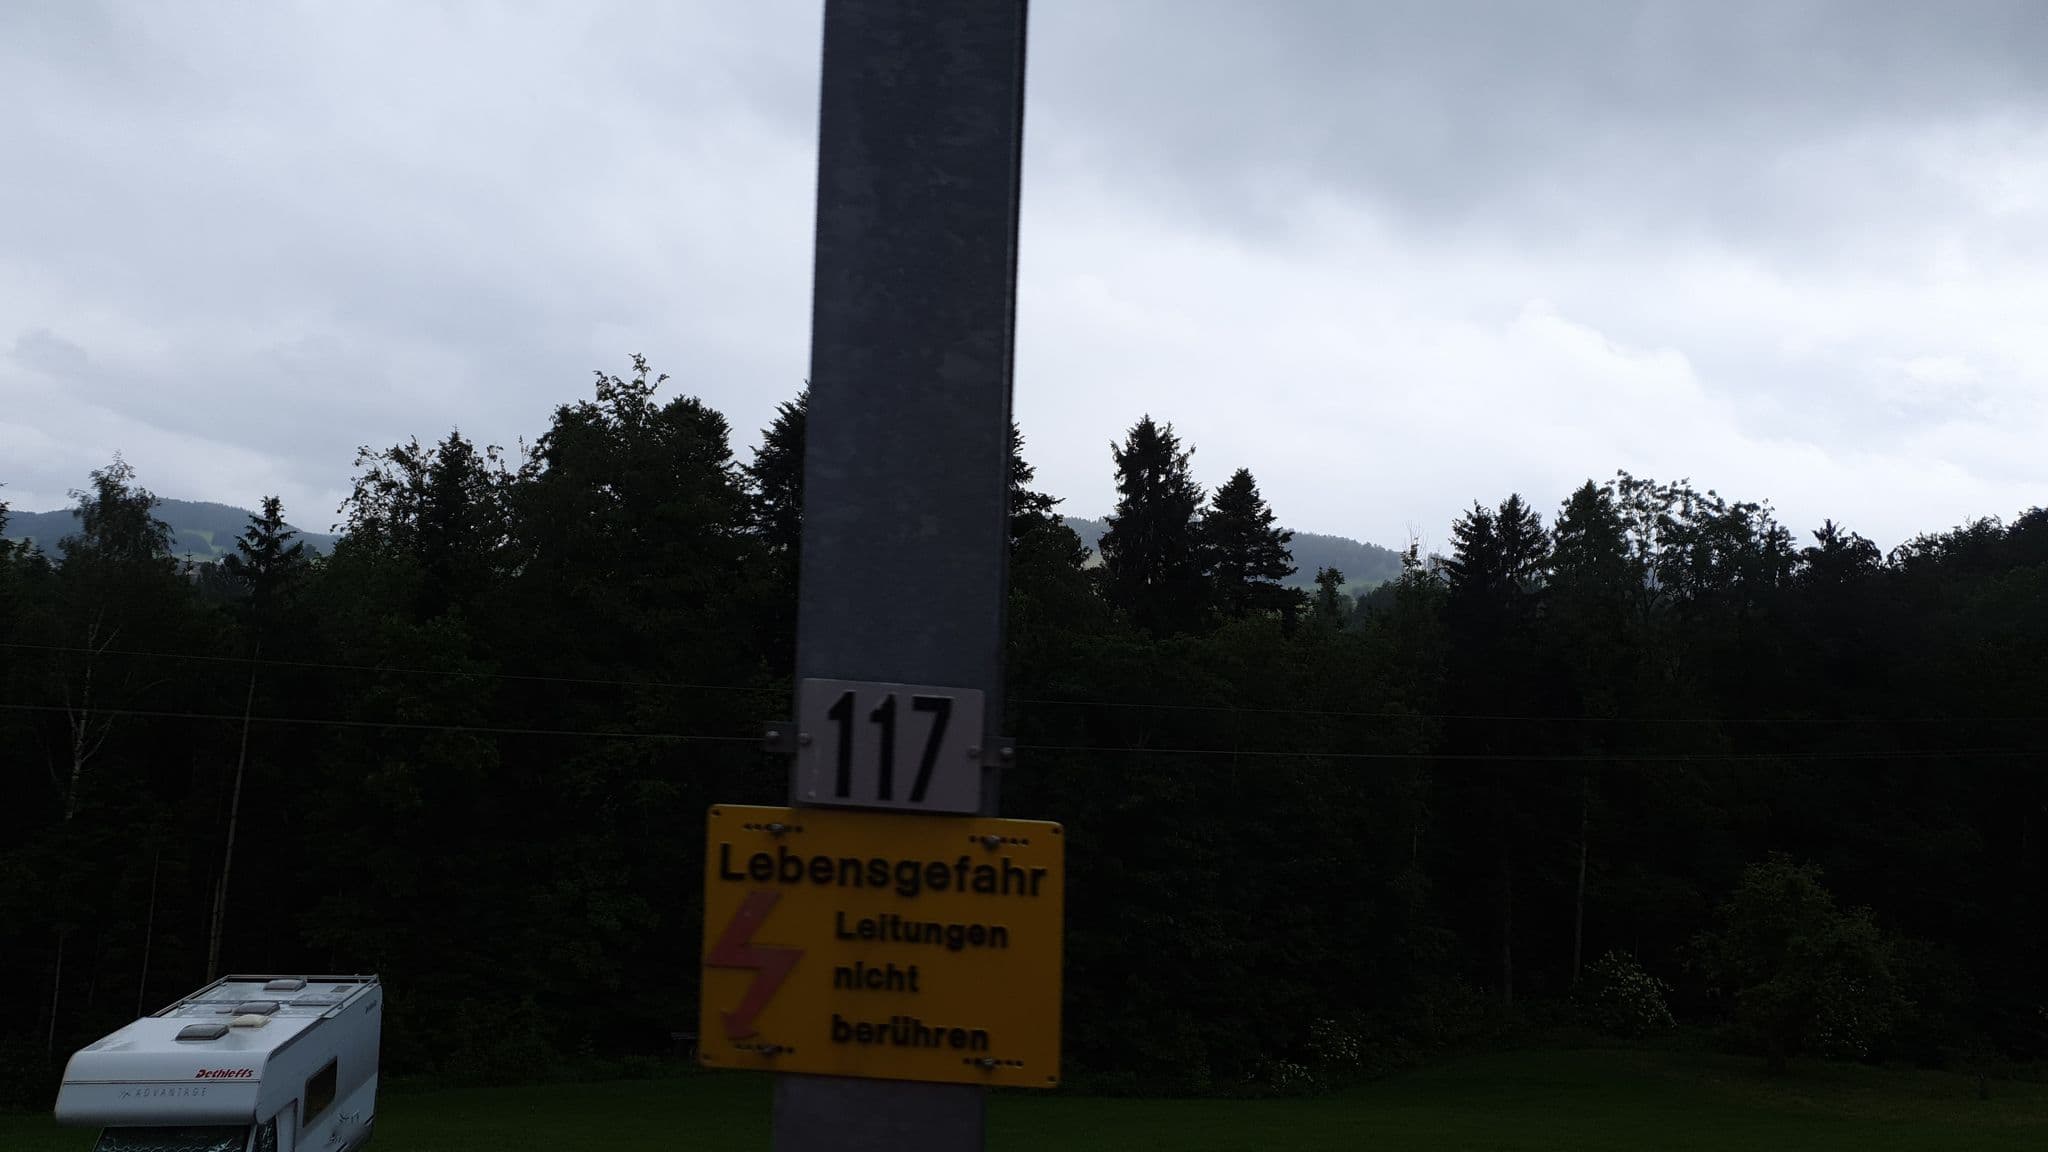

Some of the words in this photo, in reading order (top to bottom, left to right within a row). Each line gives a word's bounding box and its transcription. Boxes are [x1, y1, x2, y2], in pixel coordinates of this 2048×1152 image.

[828, 691, 954, 802] 117
[720, 843, 1047, 898] Lebensgefahr
[836, 911, 1009, 951] Leitungen
[834, 961, 920, 993] nicht
[831, 1014, 990, 1051] berühren
[136, 1087, 208, 1097] ADVANTAGE
[195, 1068, 253, 1079] Dethleffs
